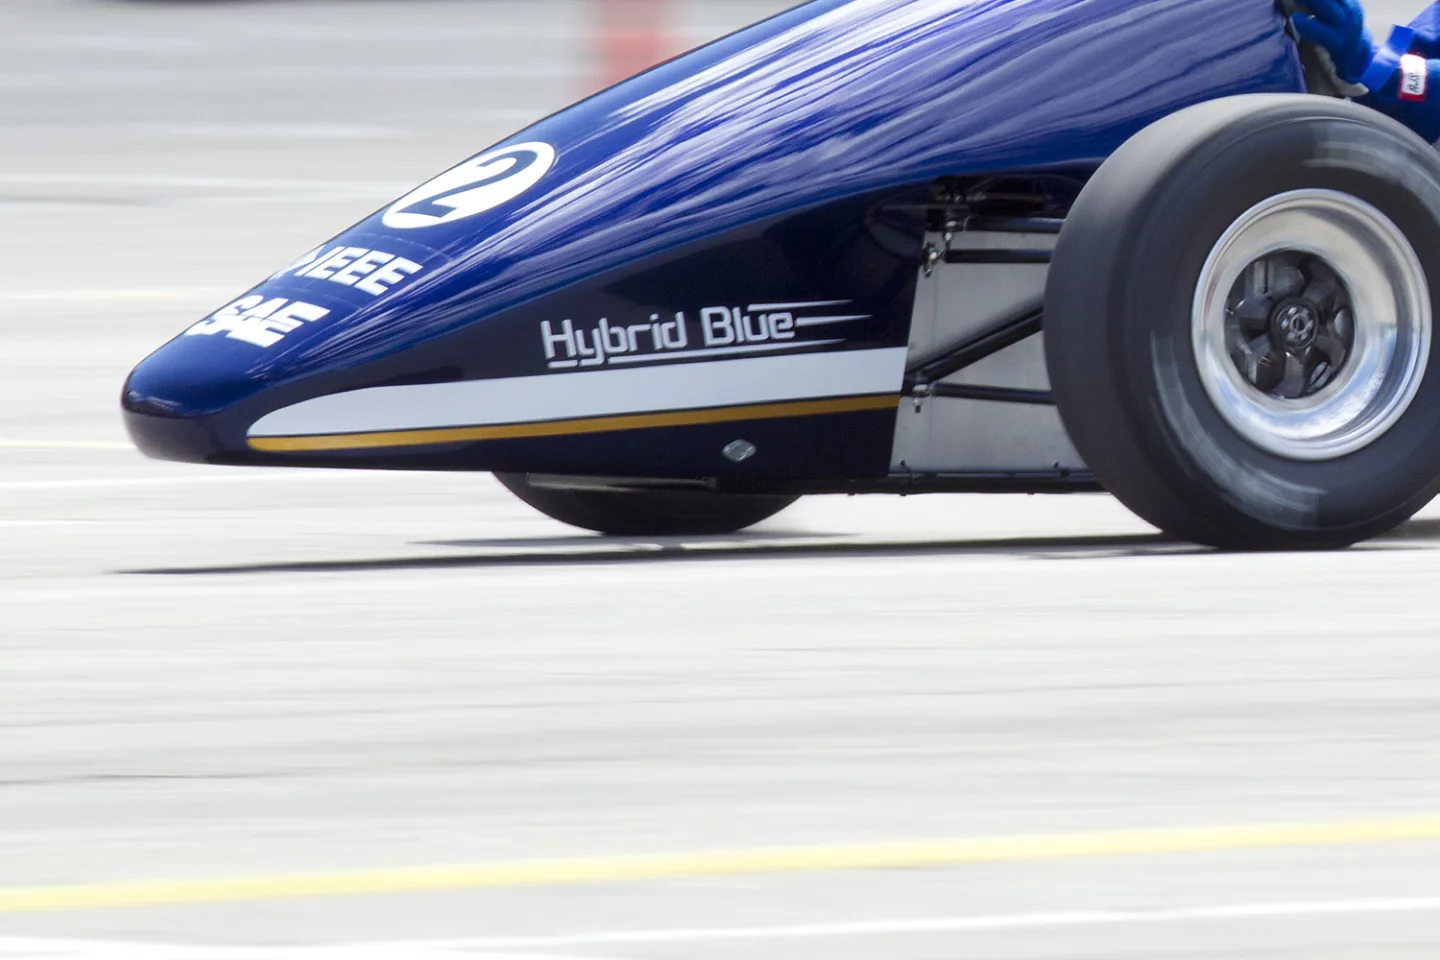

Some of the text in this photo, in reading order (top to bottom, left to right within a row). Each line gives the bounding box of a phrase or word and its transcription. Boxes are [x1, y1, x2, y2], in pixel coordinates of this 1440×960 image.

[394, 150, 538, 218] 2
[540, 305, 796, 368] Hybrid Blue
